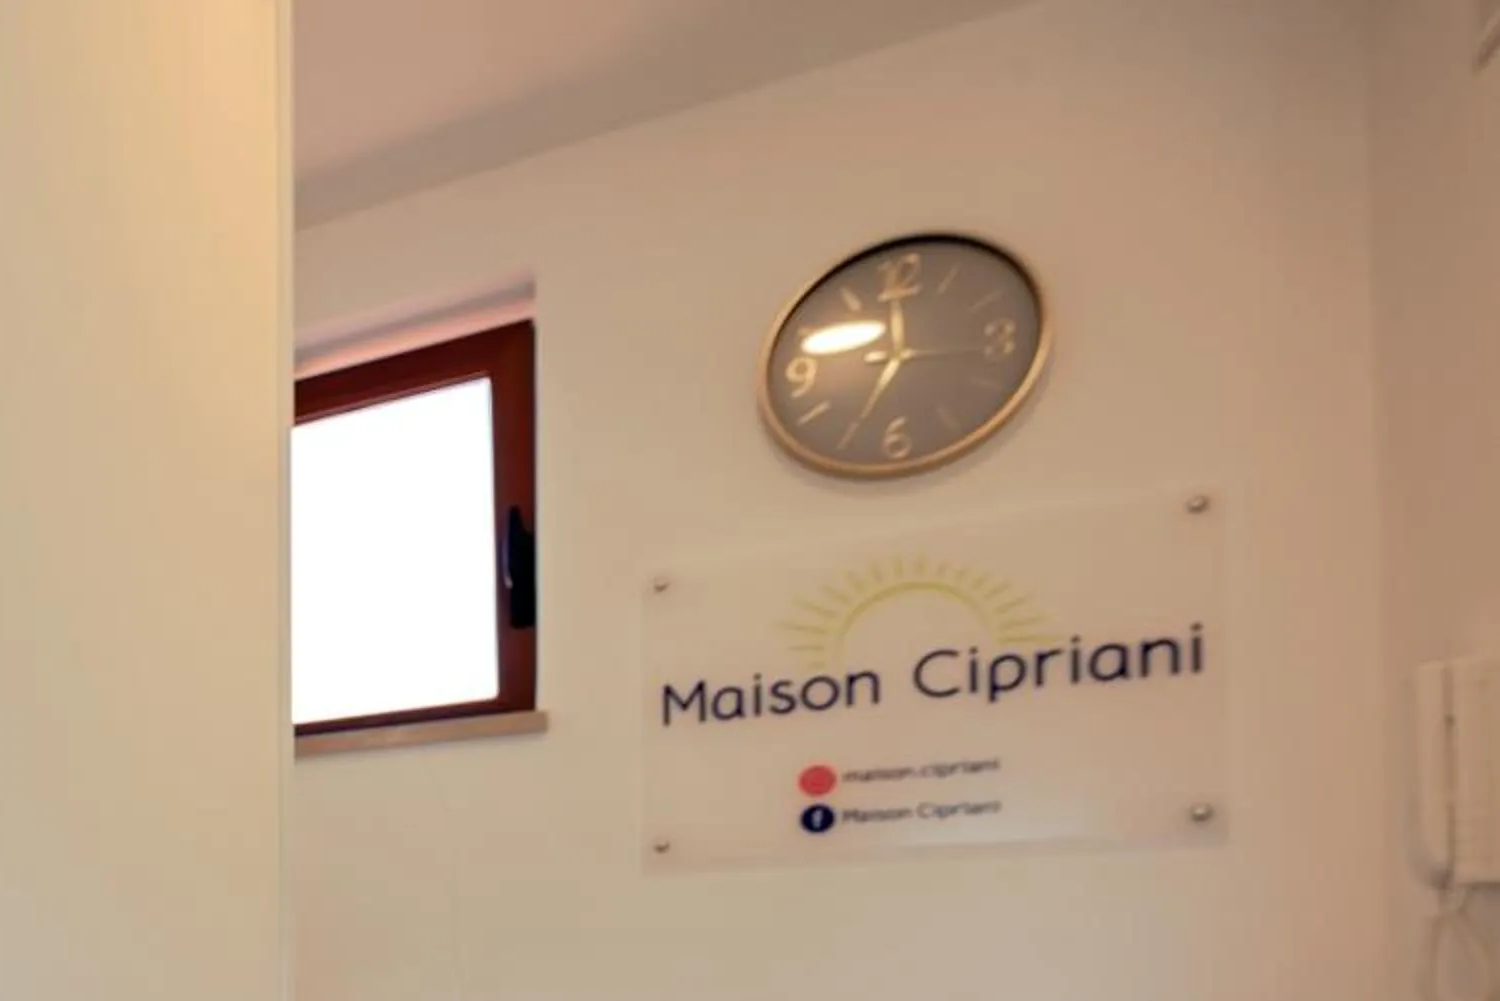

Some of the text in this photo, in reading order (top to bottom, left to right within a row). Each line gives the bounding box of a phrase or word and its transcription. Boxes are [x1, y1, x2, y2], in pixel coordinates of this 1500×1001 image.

[878, 253, 921, 302] 12
[785, 356, 817, 398] 9
[882, 416, 911, 460] 6
[662, 622, 1204, 727] Maison Cipriani
[843, 801, 1001, 823] Maison Cipriani
